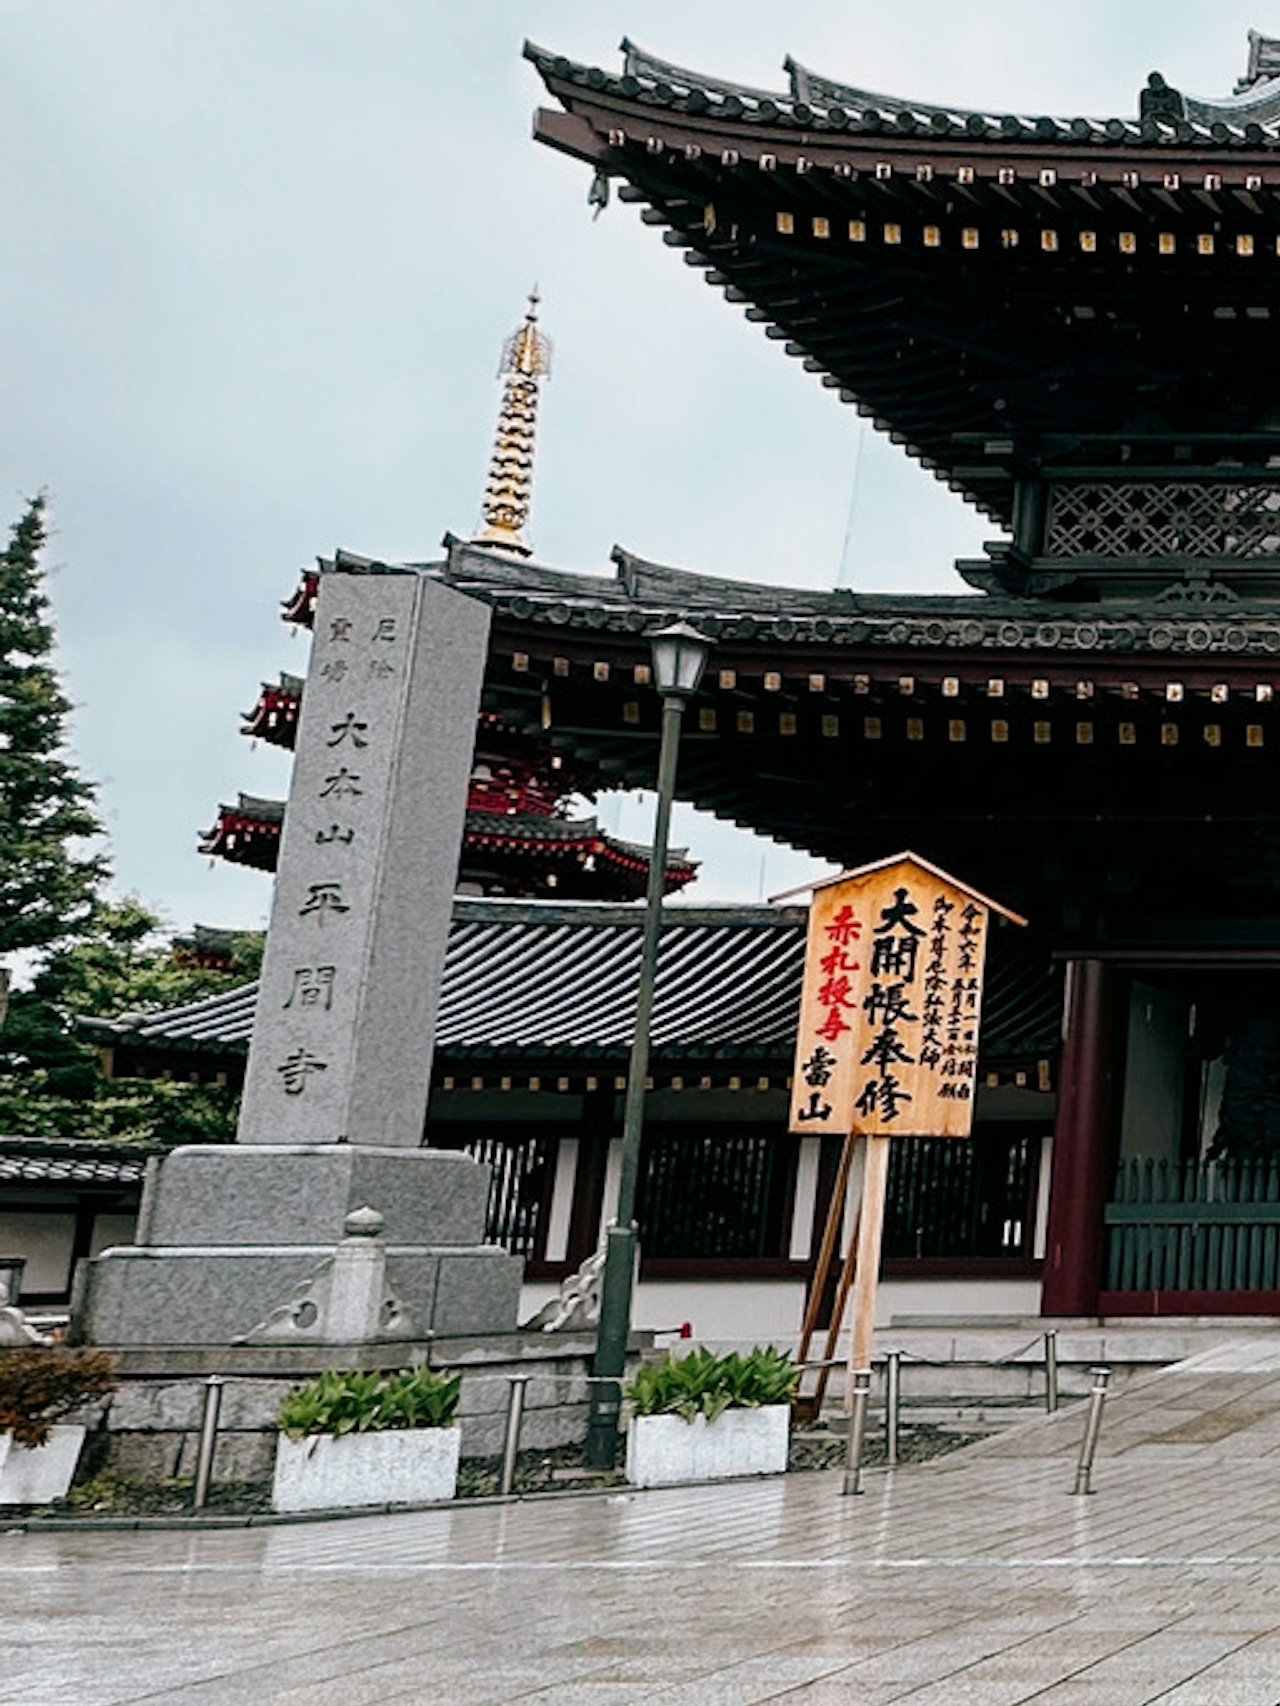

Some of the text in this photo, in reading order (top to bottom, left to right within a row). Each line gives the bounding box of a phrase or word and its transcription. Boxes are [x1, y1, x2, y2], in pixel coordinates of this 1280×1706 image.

[814, 904, 863, 1042] 赤札授与
[854, 887, 928, 1124] 大開帳奉修
